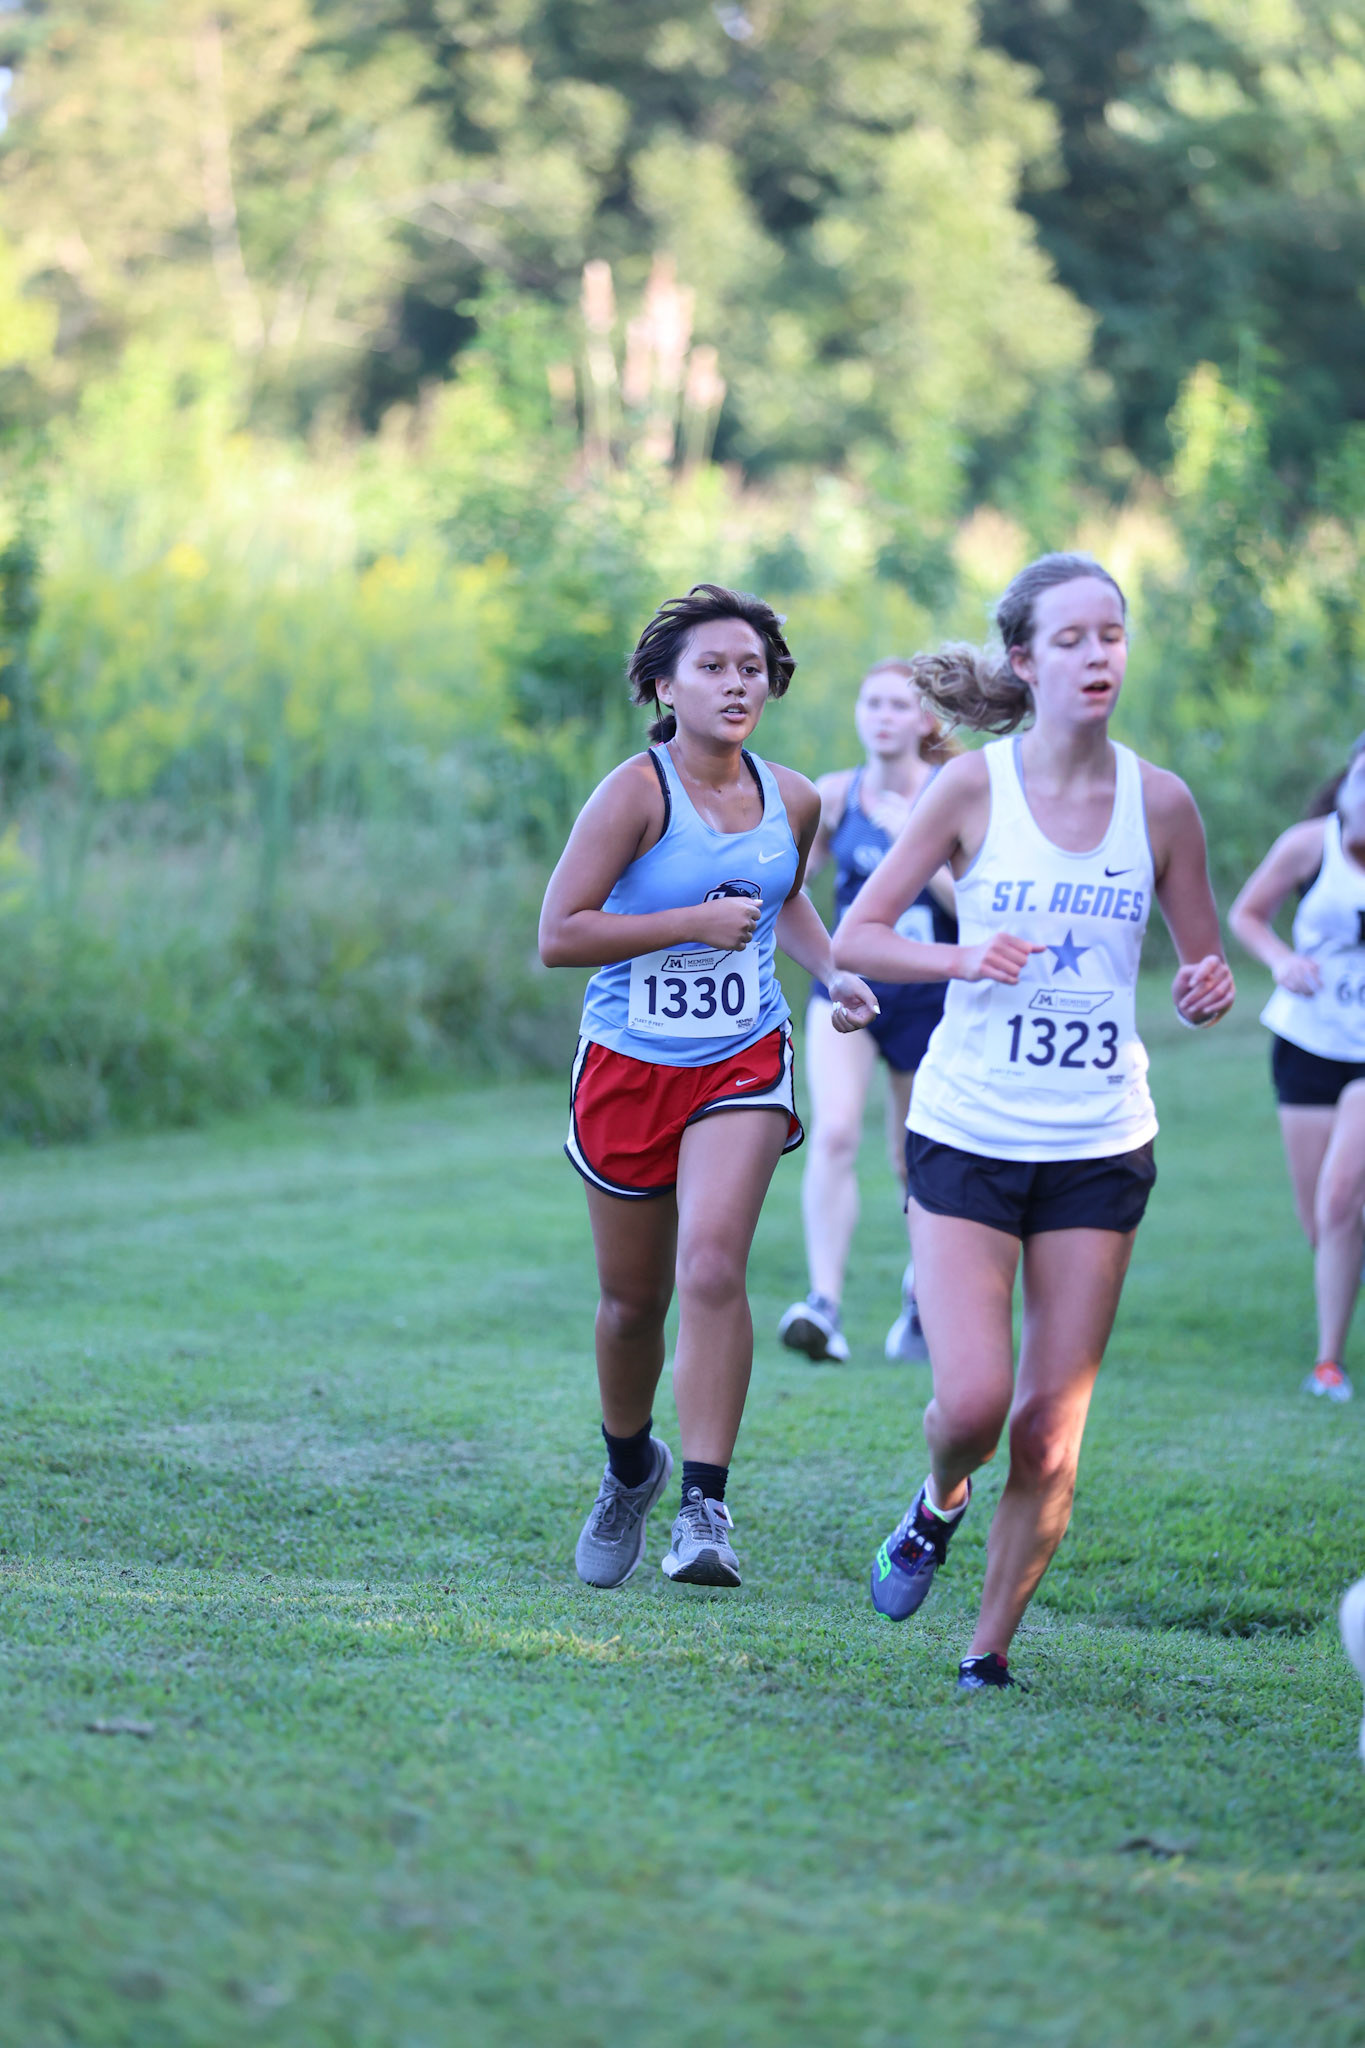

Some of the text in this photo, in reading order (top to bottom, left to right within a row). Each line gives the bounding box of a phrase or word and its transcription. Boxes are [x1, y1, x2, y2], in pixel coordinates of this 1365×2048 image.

[992, 881, 1144, 922] ST. AGNES
[669, 959, 683, 968] M
[644, 972, 745, 1019] 1330
[1007, 1014, 1119, 1069] 1323
